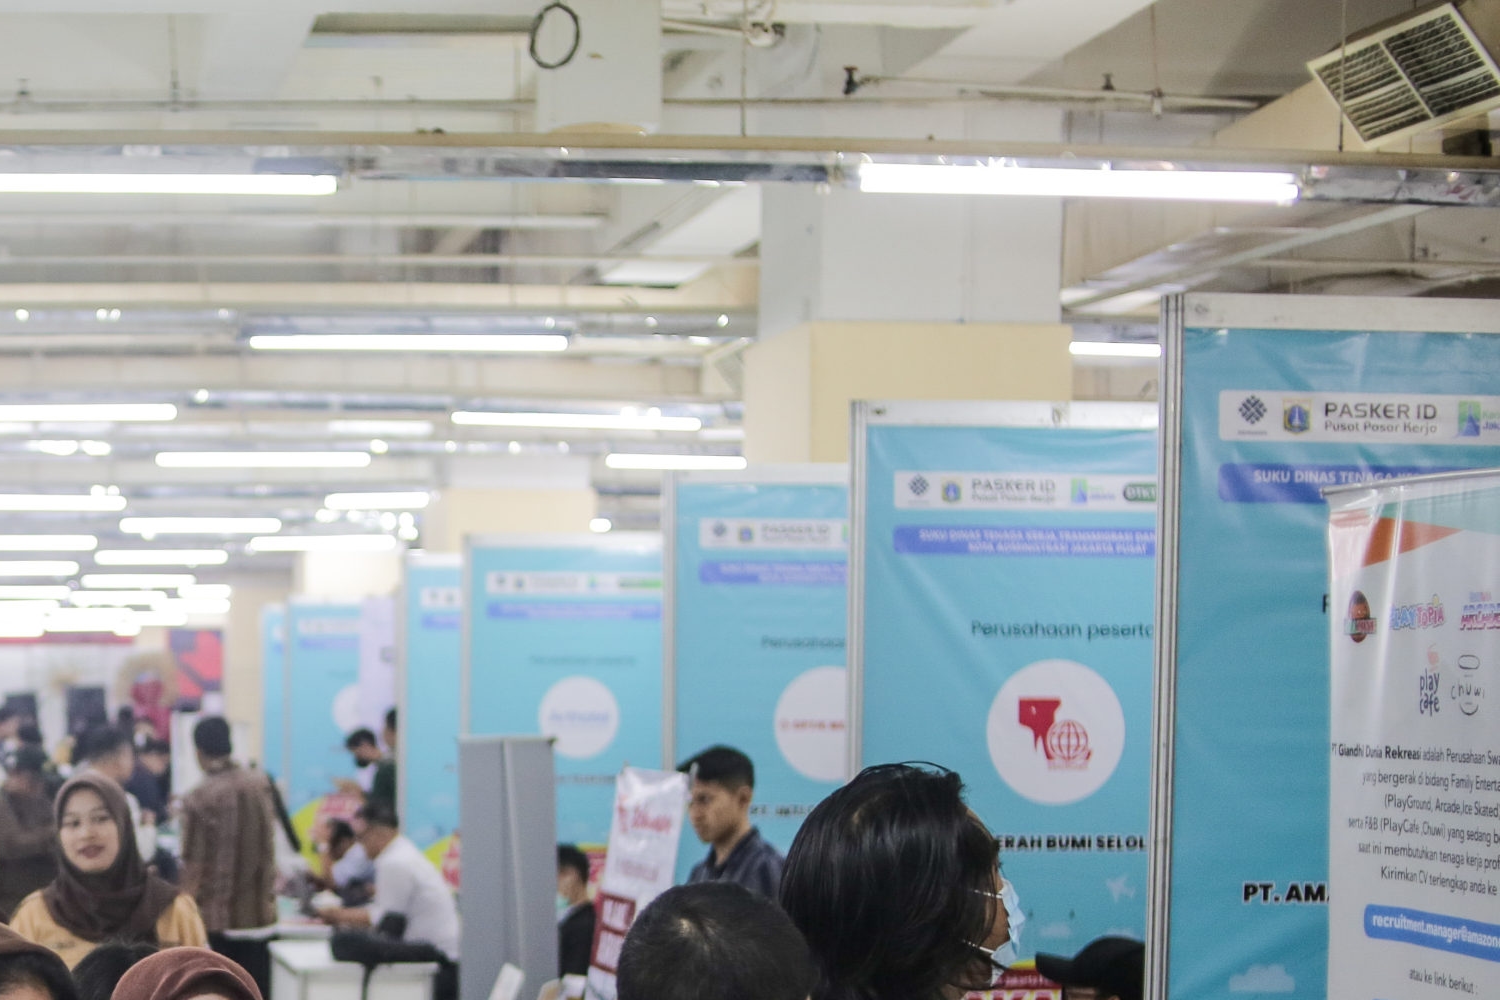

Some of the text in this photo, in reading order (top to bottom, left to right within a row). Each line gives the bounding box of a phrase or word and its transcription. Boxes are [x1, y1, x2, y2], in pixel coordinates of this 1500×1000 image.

[1324, 402, 1438, 420] PASKER ID
[1253, 470, 1290, 484] SUKU
[1295, 471, 1337, 485] DINAS
[971, 620, 1083, 638] Perusahaan
[1419, 668, 1440, 696] play
[1419, 692, 1440, 716] cafe
[1385, 745, 1421, 760] Rekreasi
[1446, 747, 1486, 765] Perusahaan
[1378, 770, 1416, 788] bergerak
[1425, 772, 1449, 791] bidang
[1451, 773, 1473, 793] Family
[996, 835, 1043, 850] ERAH
[1046, 835, 1093, 850] BUMI
[1447, 826, 1465, 843] yang
[1466, 827, 1491, 848] sedang
[1384, 844, 1438, 862] membutuhkan
[1439, 850, 1465, 869] tenaga
[1466, 854, 1483, 872] kerja
[1381, 866, 1498, 897] Kirimkan CV terlengkap anda ke
[1243, 883, 1329, 902] PT. AM
[1434, 974, 1447, 988] link
[1448, 976, 1474, 994] berikut
